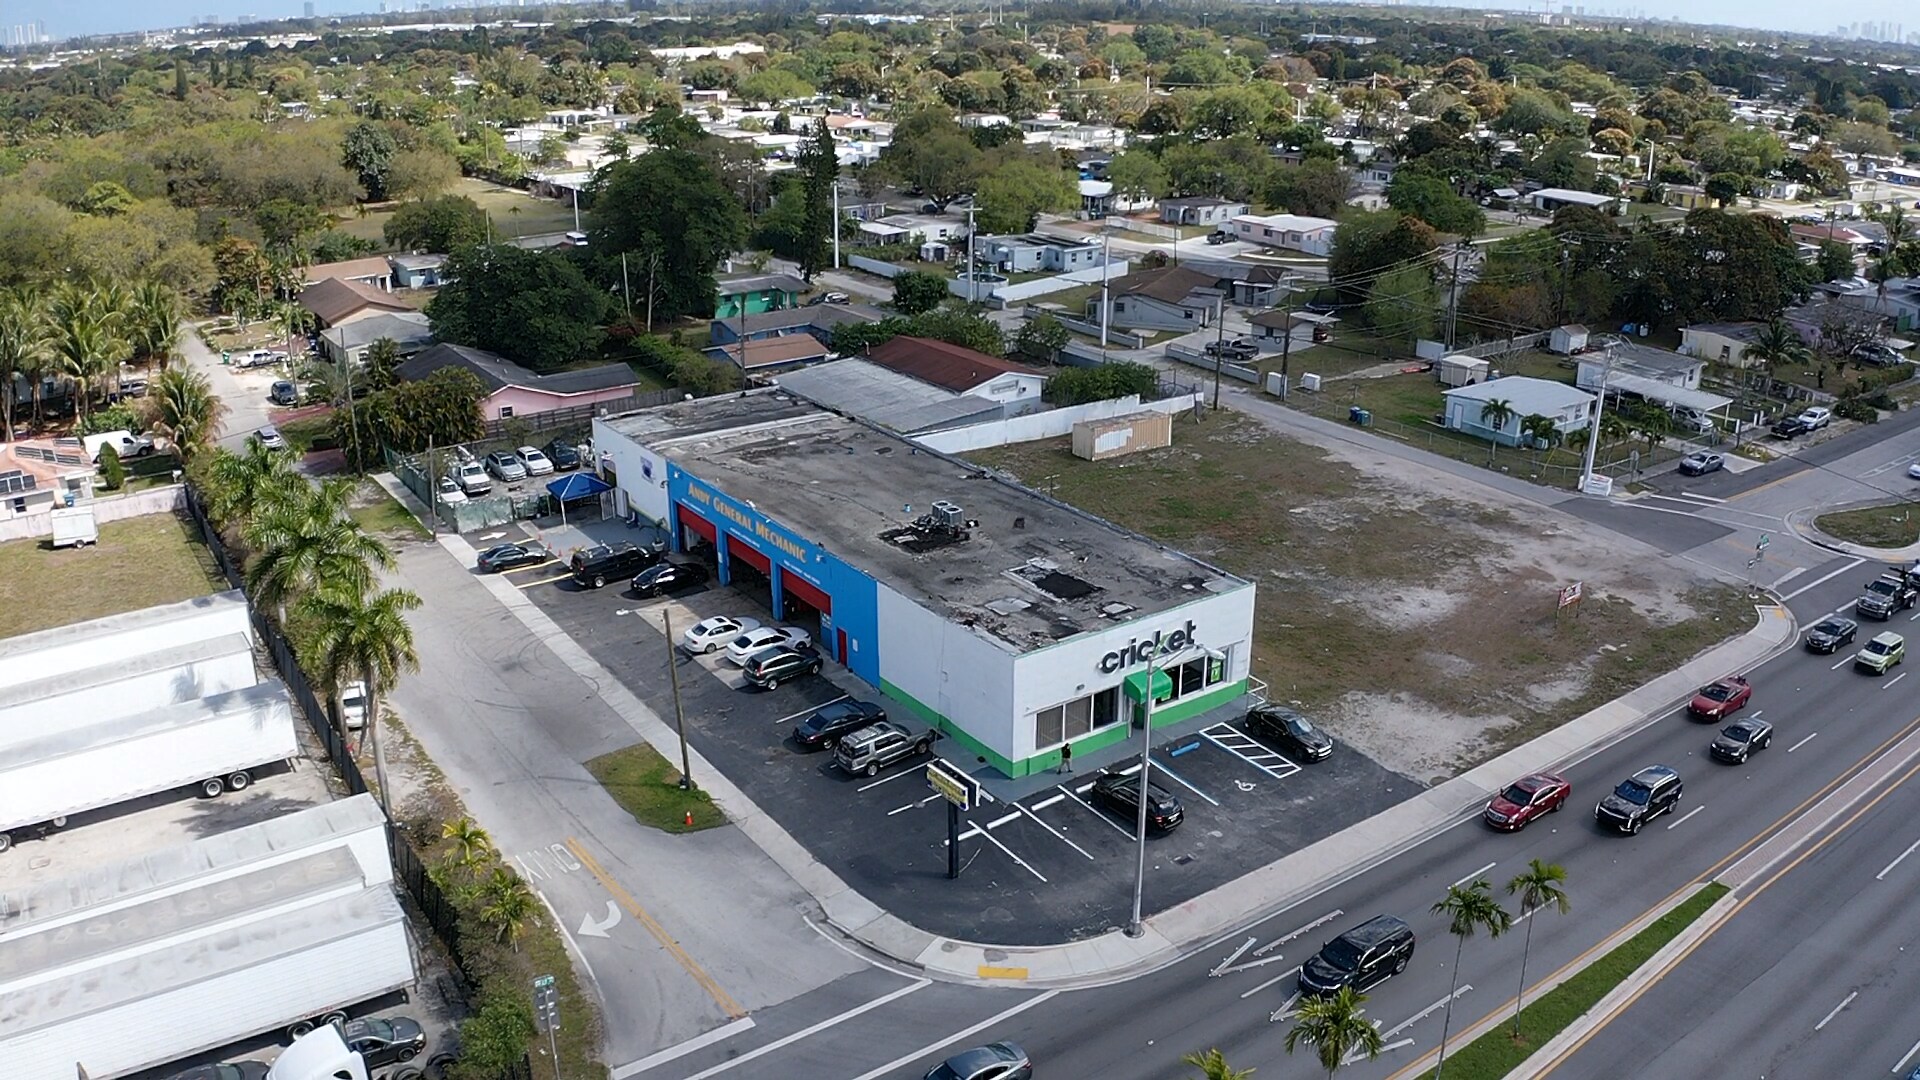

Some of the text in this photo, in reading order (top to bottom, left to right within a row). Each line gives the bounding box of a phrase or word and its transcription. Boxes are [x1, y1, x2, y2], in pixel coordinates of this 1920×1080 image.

[688, 482, 711, 506] ANDY
[713, 496, 754, 533] GENERAL
[755, 520, 807, 564] MECHANIC
[1100, 619, 1197, 674] cricket
